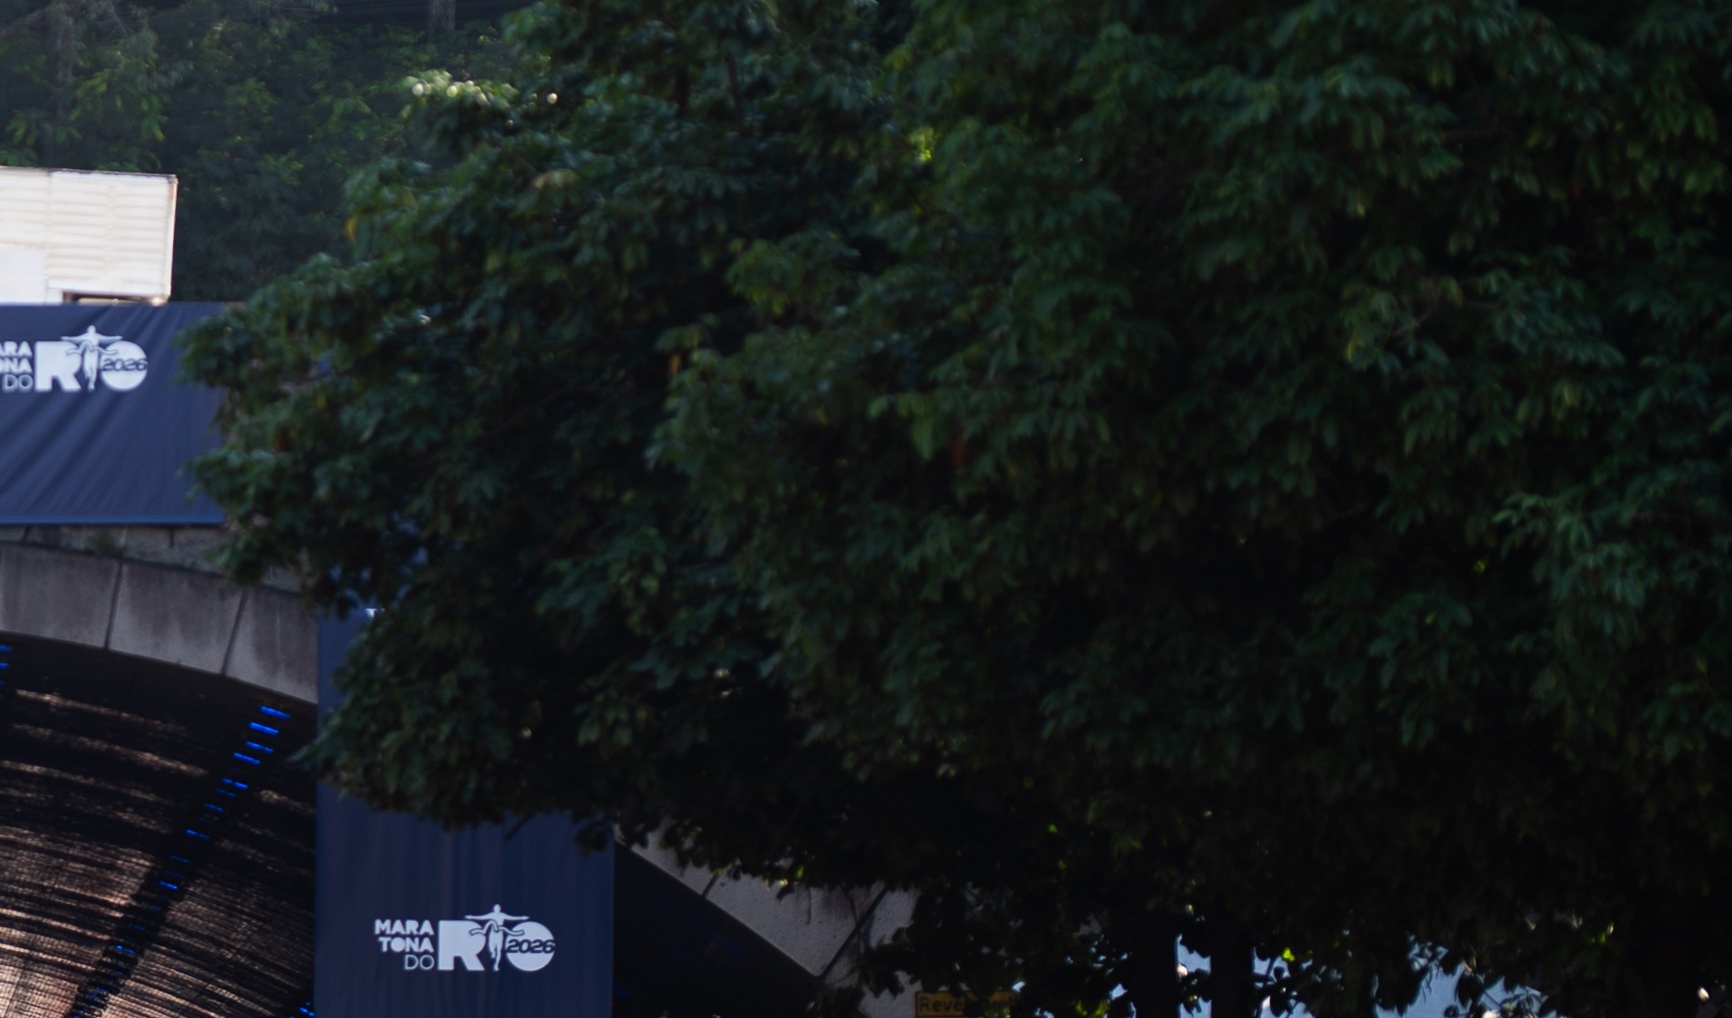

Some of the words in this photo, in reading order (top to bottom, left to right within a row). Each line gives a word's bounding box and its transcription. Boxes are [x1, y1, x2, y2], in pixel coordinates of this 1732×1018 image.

[101, 357, 149, 372] 2026
[2, 374, 34, 392] DO
[374, 919, 435, 935] MARA
[378, 937, 434, 953] TONA
[506, 939, 556, 954] 2026
[404, 954, 435, 971] DO
